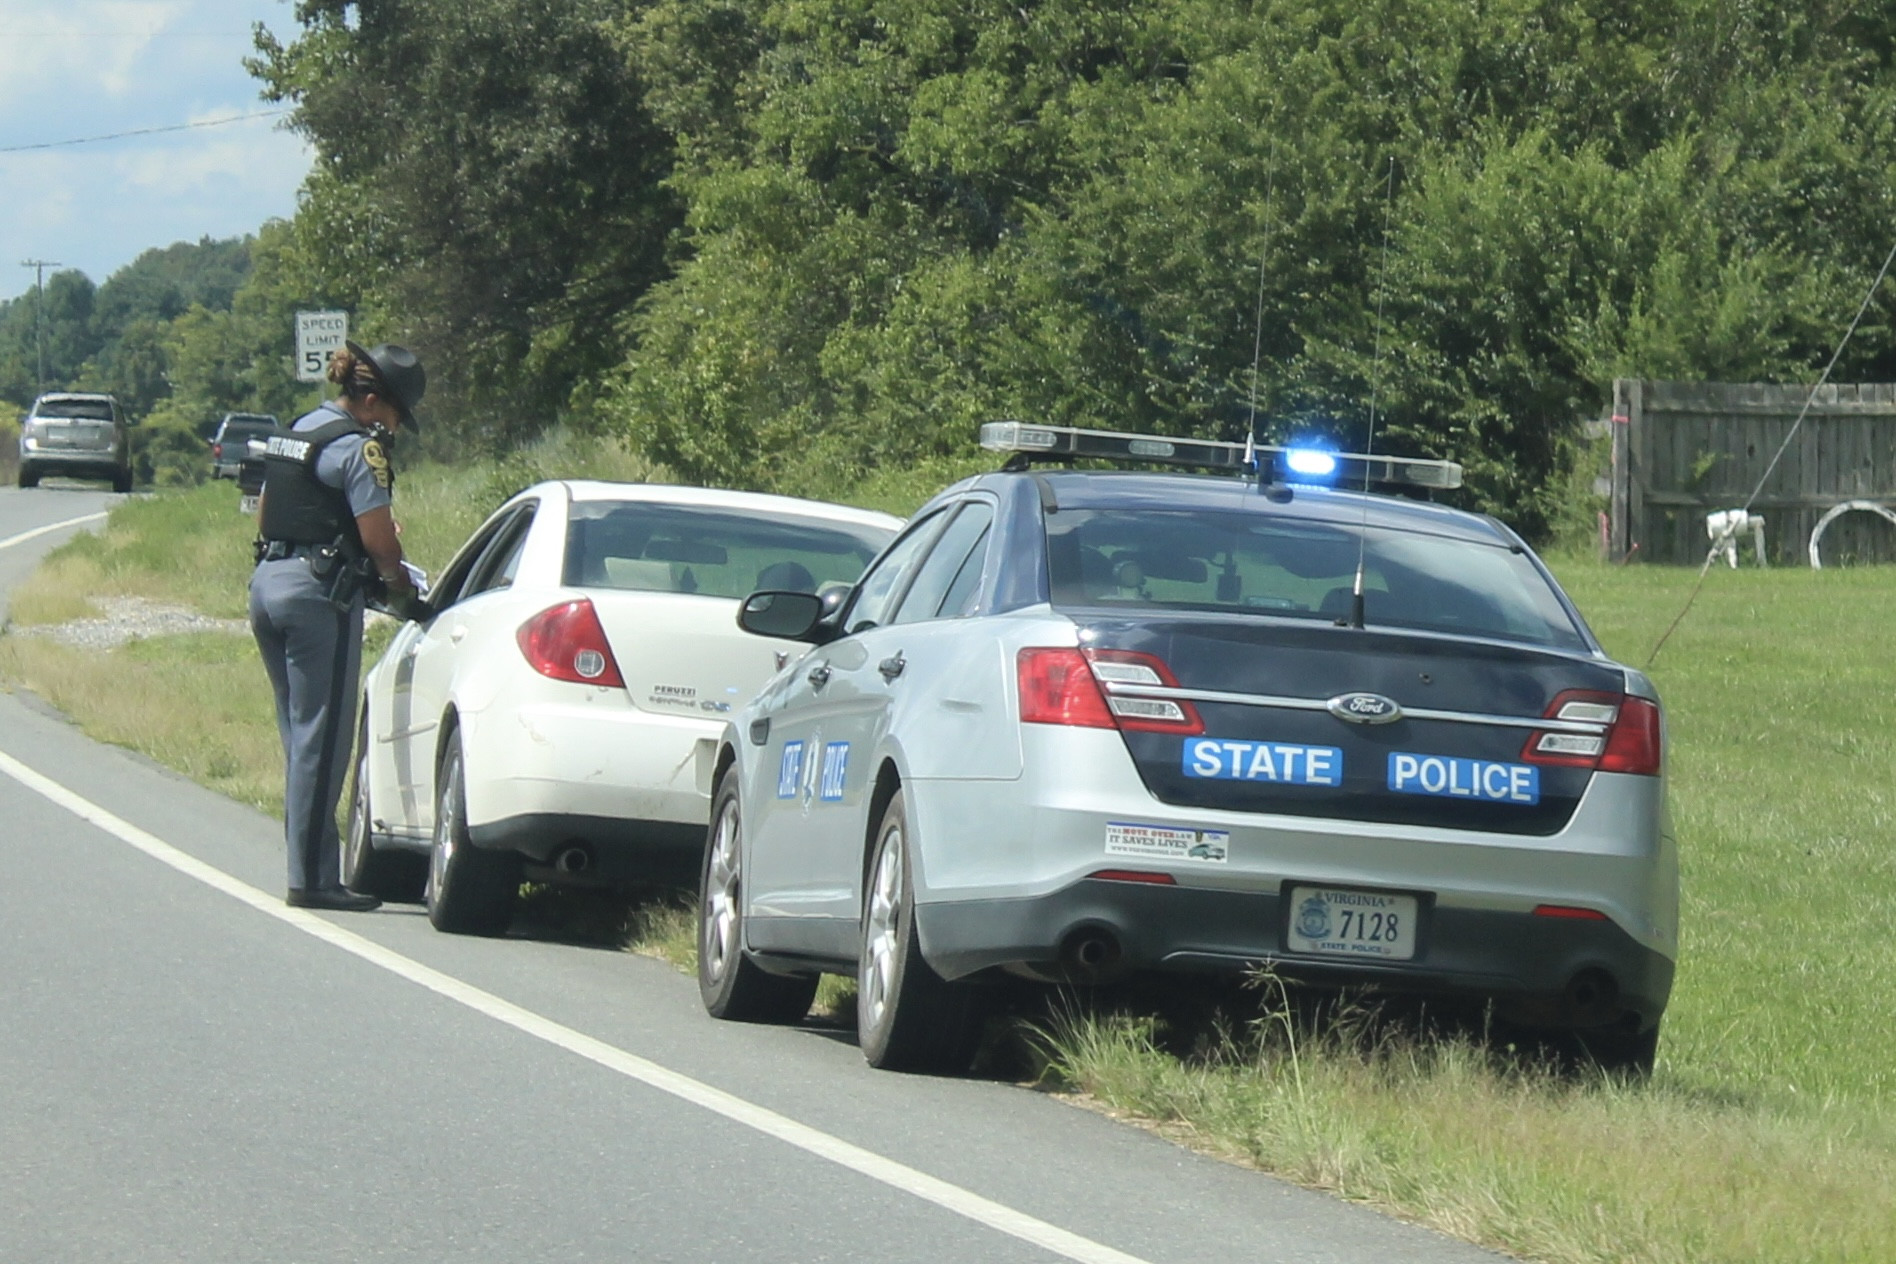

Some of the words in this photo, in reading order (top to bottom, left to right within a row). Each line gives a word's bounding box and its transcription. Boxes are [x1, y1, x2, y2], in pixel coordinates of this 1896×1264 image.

[302, 319, 344, 330] SPEED
[306, 334, 339, 346] LIMIT
[279, 438, 312, 461] POLICE
[654, 685, 696, 697] PERUZZI
[1349, 696, 1385, 715] Ford
[1192, 740, 1334, 785] STATE
[1394, 755, 1533, 801] POLICE
[1107, 827, 1121, 835] THE
[1122, 828, 1149, 837] MOVE
[1151, 830, 1175, 839] OVER
[1109, 834, 1121, 843] IT
[1122, 835, 1156, 846] SAVES
[1157, 838, 1188, 849] LIVES
[1325, 891, 1386, 908] VIRGINIA
[1340, 909, 1398, 942] 7128
[1321, 942, 1346, 950] STATE
[1352, 944, 1382, 953] POLICE
